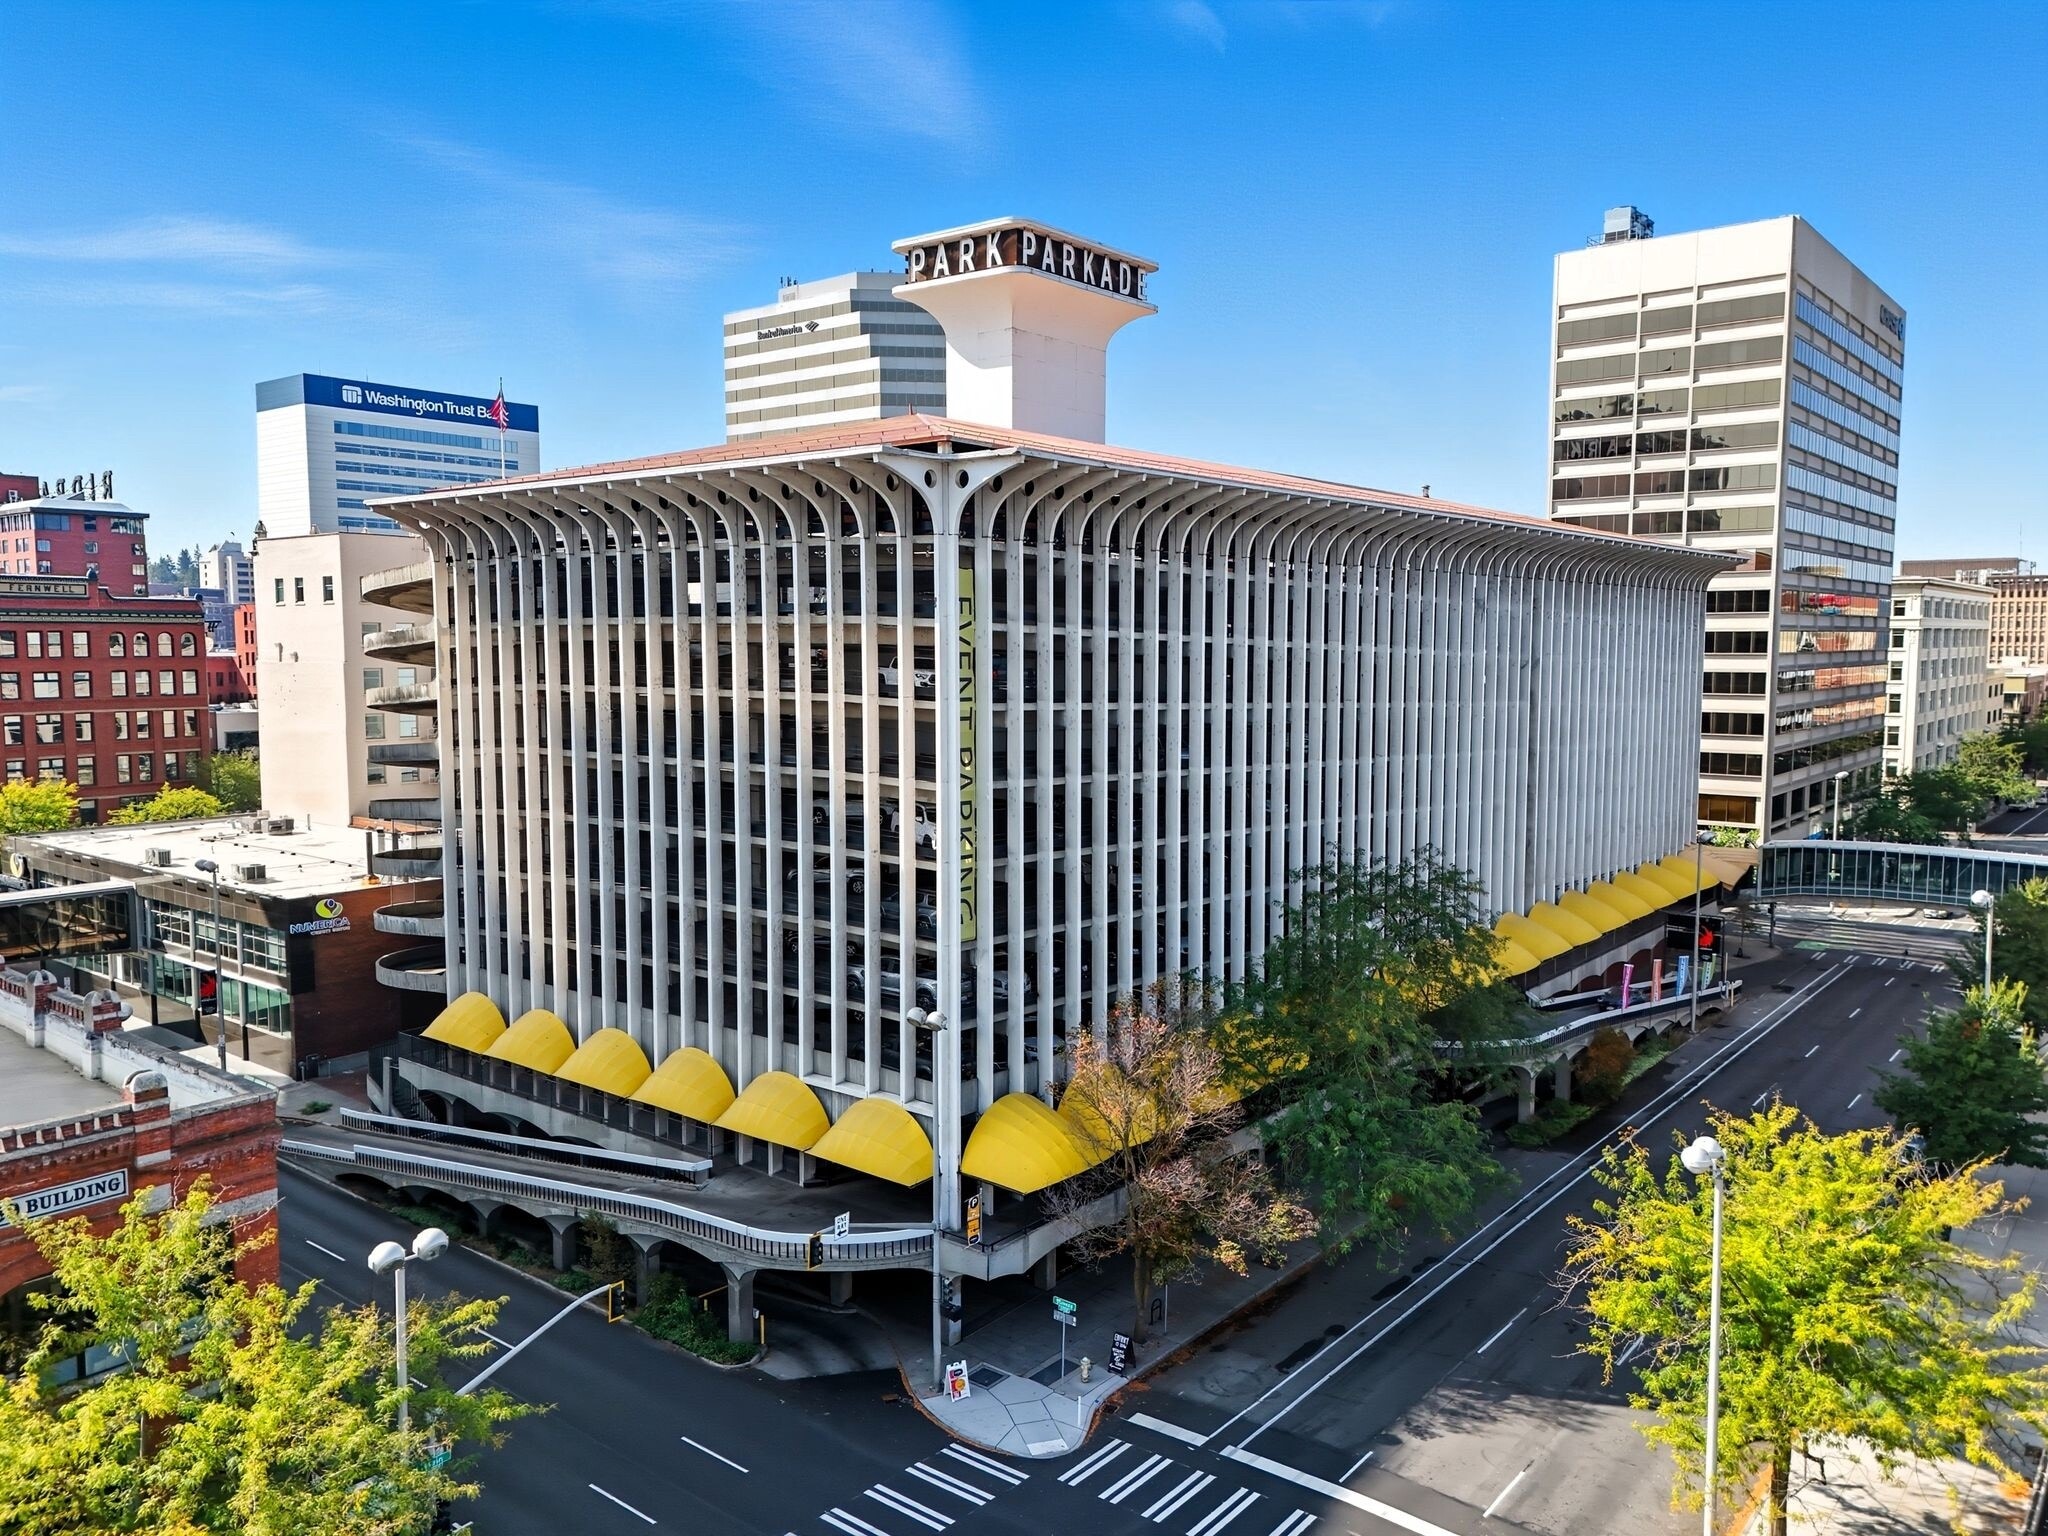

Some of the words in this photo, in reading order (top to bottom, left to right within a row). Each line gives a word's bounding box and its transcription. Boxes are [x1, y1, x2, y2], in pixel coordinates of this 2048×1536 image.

[910, 231, 1003, 283] PARK
[1022, 230, 1147, 300] PARKADE
[365, 390, 443, 415] Washington
[443, 401, 475, 417] Trust
[9, 584, 74, 593] FERNWELL
[959, 597, 973, 730] EVENT
[959, 747, 973, 924] PARKING
[289, 916, 351, 935] NUMERICA
[25, 1177, 120, 1213] BUILDING
